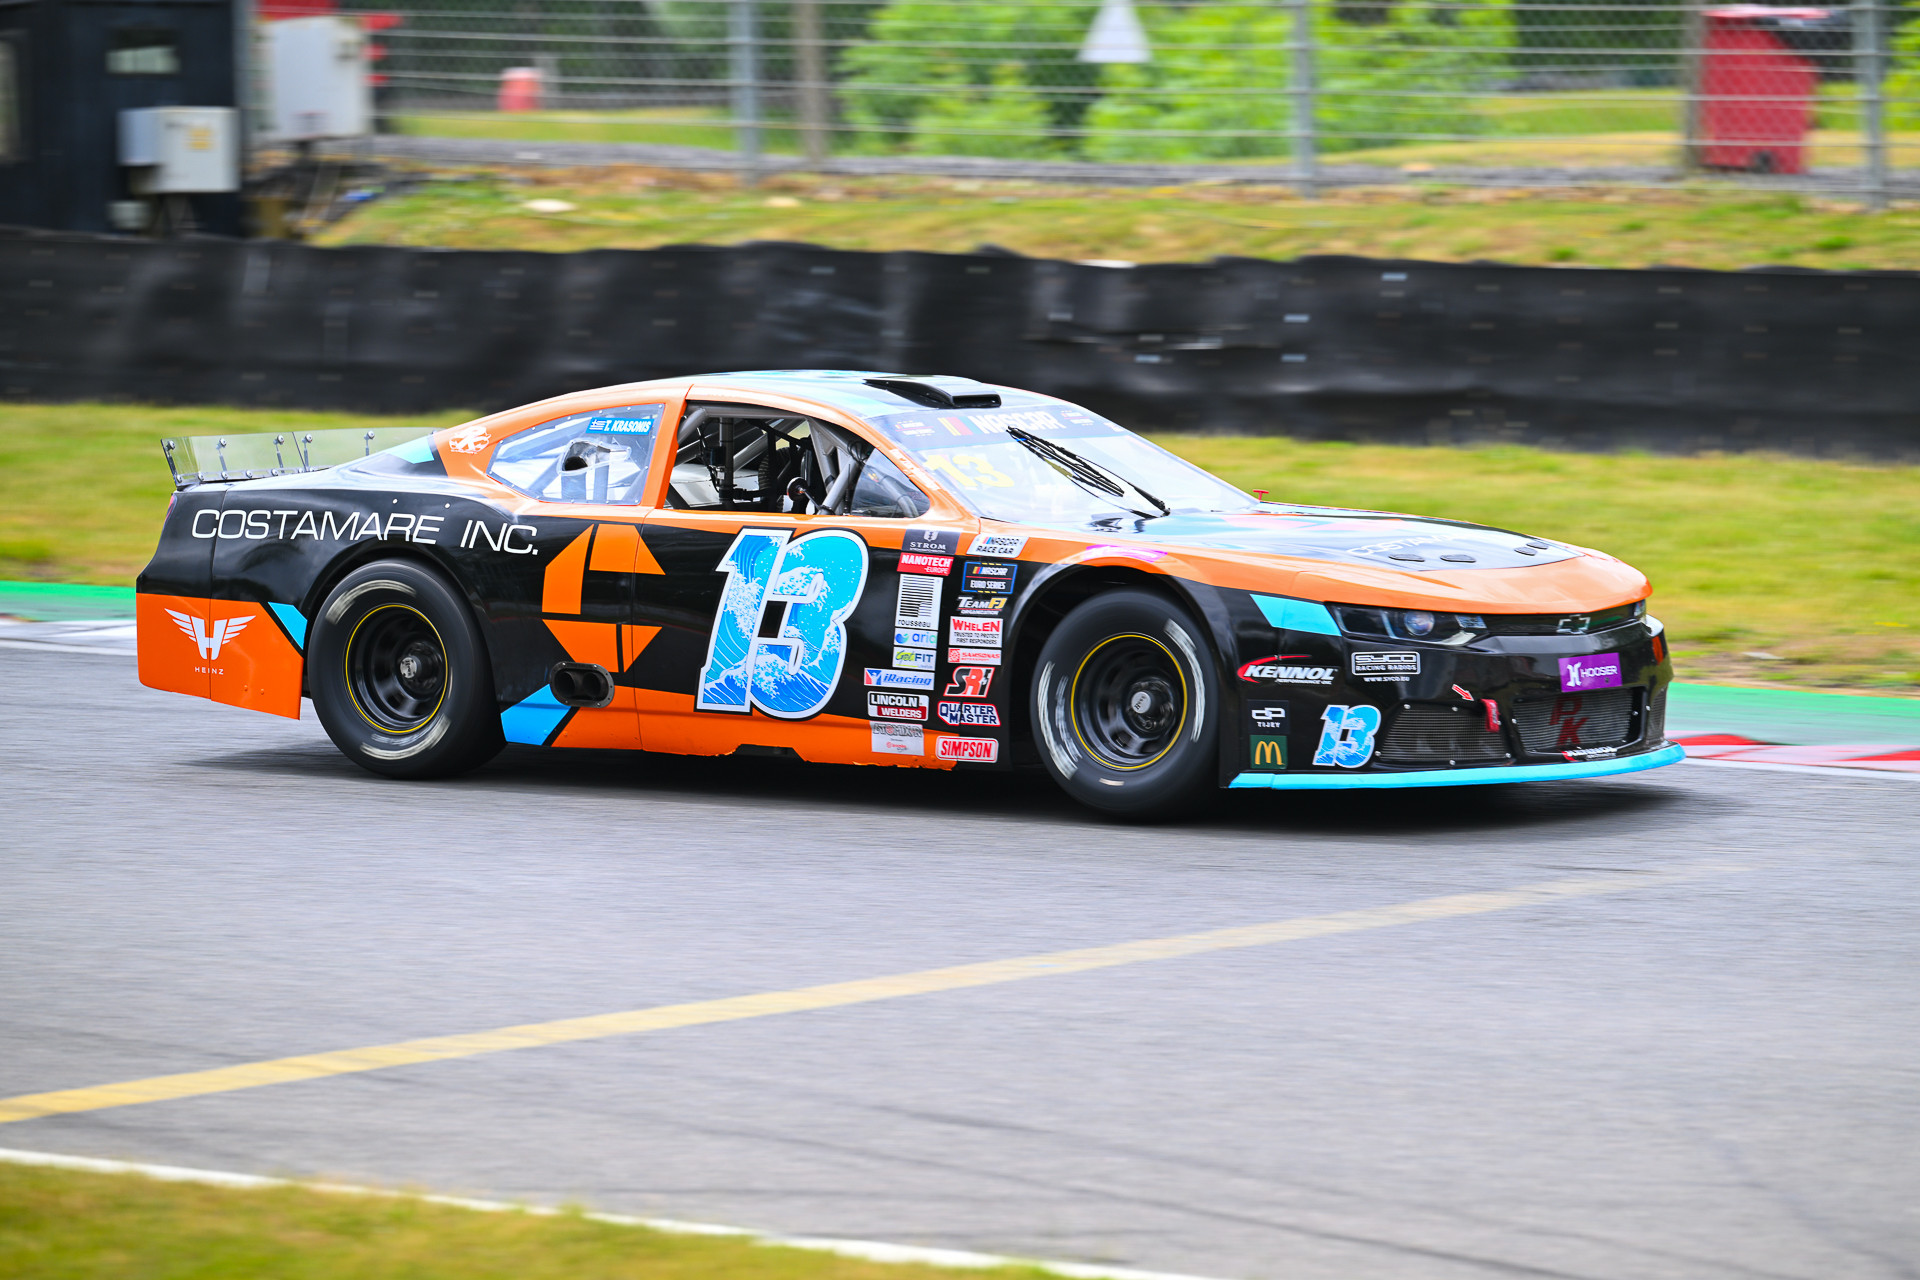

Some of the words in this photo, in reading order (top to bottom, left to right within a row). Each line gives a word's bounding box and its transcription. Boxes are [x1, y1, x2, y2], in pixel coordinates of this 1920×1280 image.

[603, 420, 610, 431] T.
[612, 421, 652, 433] KRASONIS
[924, 454, 1014, 488] 13
[191, 509, 445, 544] COSTAMARE
[460, 519, 539, 555] INC.
[909, 541, 947, 550] STROM
[976, 545, 997, 553] RACE
[901, 554, 952, 567] NANOTECH
[970, 579, 985, 589] EURO
[985, 580, 1006, 590] SERIES
[697, 528, 869, 719] 13
[898, 618, 932, 628] rousseau
[952, 618, 1000, 632] WHELEN
[1355, 655, 1417, 663] SYCO
[194, 666, 224, 675] HEINZ
[1244, 665, 1334, 681] KENNOL
[883, 672, 932, 686] iRacing
[871, 694, 918, 707] LINCOLN
[881, 707, 922, 719] WELDERS
[939, 703, 994, 717] QUARTER
[950, 713, 997, 724] MASTER
[1312, 704, 1382, 768] 13
[941, 740, 992, 758] SIMPSON
